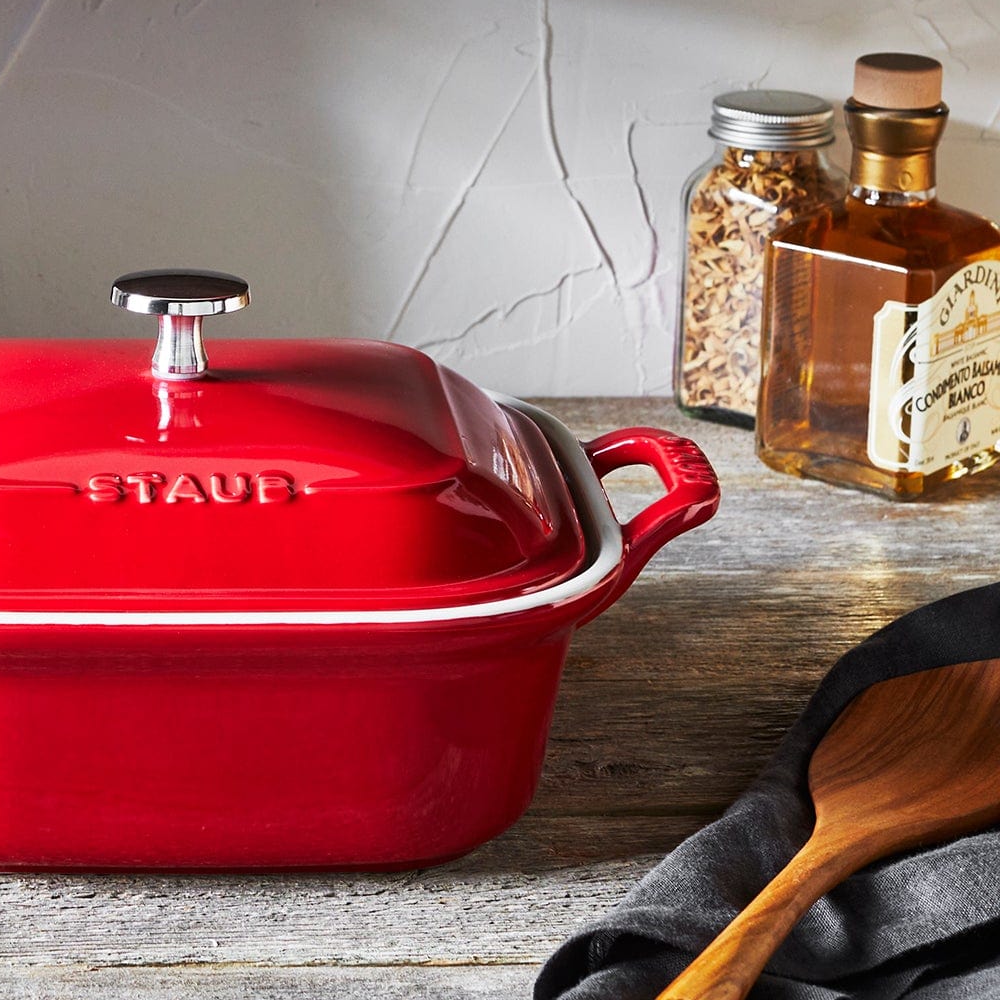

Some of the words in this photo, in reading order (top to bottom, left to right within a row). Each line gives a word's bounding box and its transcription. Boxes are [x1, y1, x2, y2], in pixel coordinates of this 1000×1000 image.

[940, 265, 1000, 326] GIARDIN
[916, 366, 970, 412] CONDIMENTO
[948, 380, 985, 409] BIANCO
[88, 471, 295, 504] STAUB
